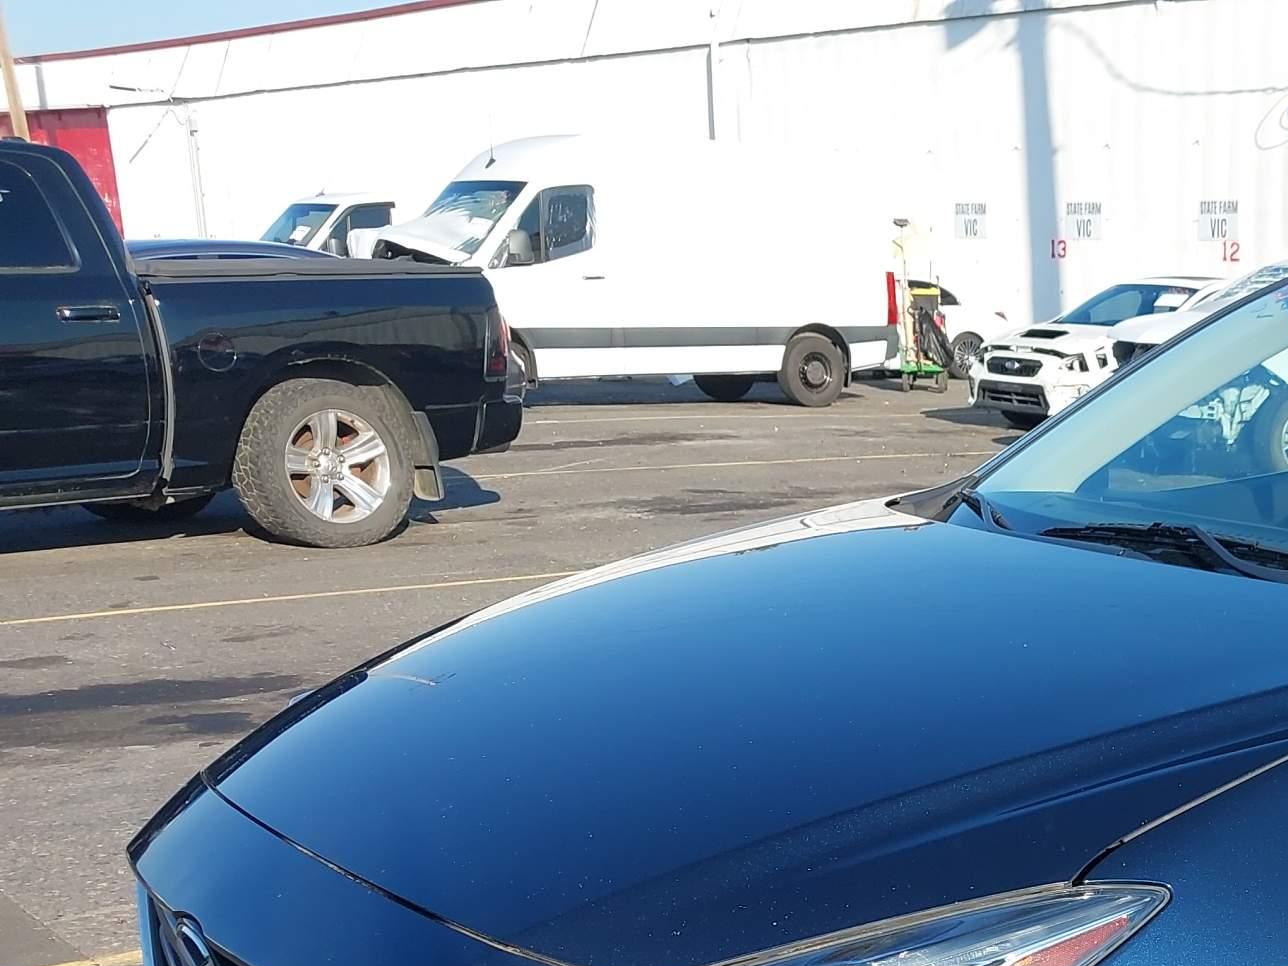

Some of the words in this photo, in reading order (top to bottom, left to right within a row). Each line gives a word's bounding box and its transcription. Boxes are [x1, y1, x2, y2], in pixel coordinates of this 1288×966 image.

[955, 203, 970, 215] STATE
[971, 203, 987, 215] FARM
[1066, 202, 1083, 215] STATE
[1084, 202, 1101, 215] FARM
[1200, 201, 1217, 214] STATE
[1219, 201, 1238, 214] FARM
[963, 218, 978, 237] VIC
[1076, 218, 1092, 237] VIC
[1210, 218, 1227, 238] VIC
[1051, 239, 1067, 258] 13
[1222, 240, 1240, 262] 12
